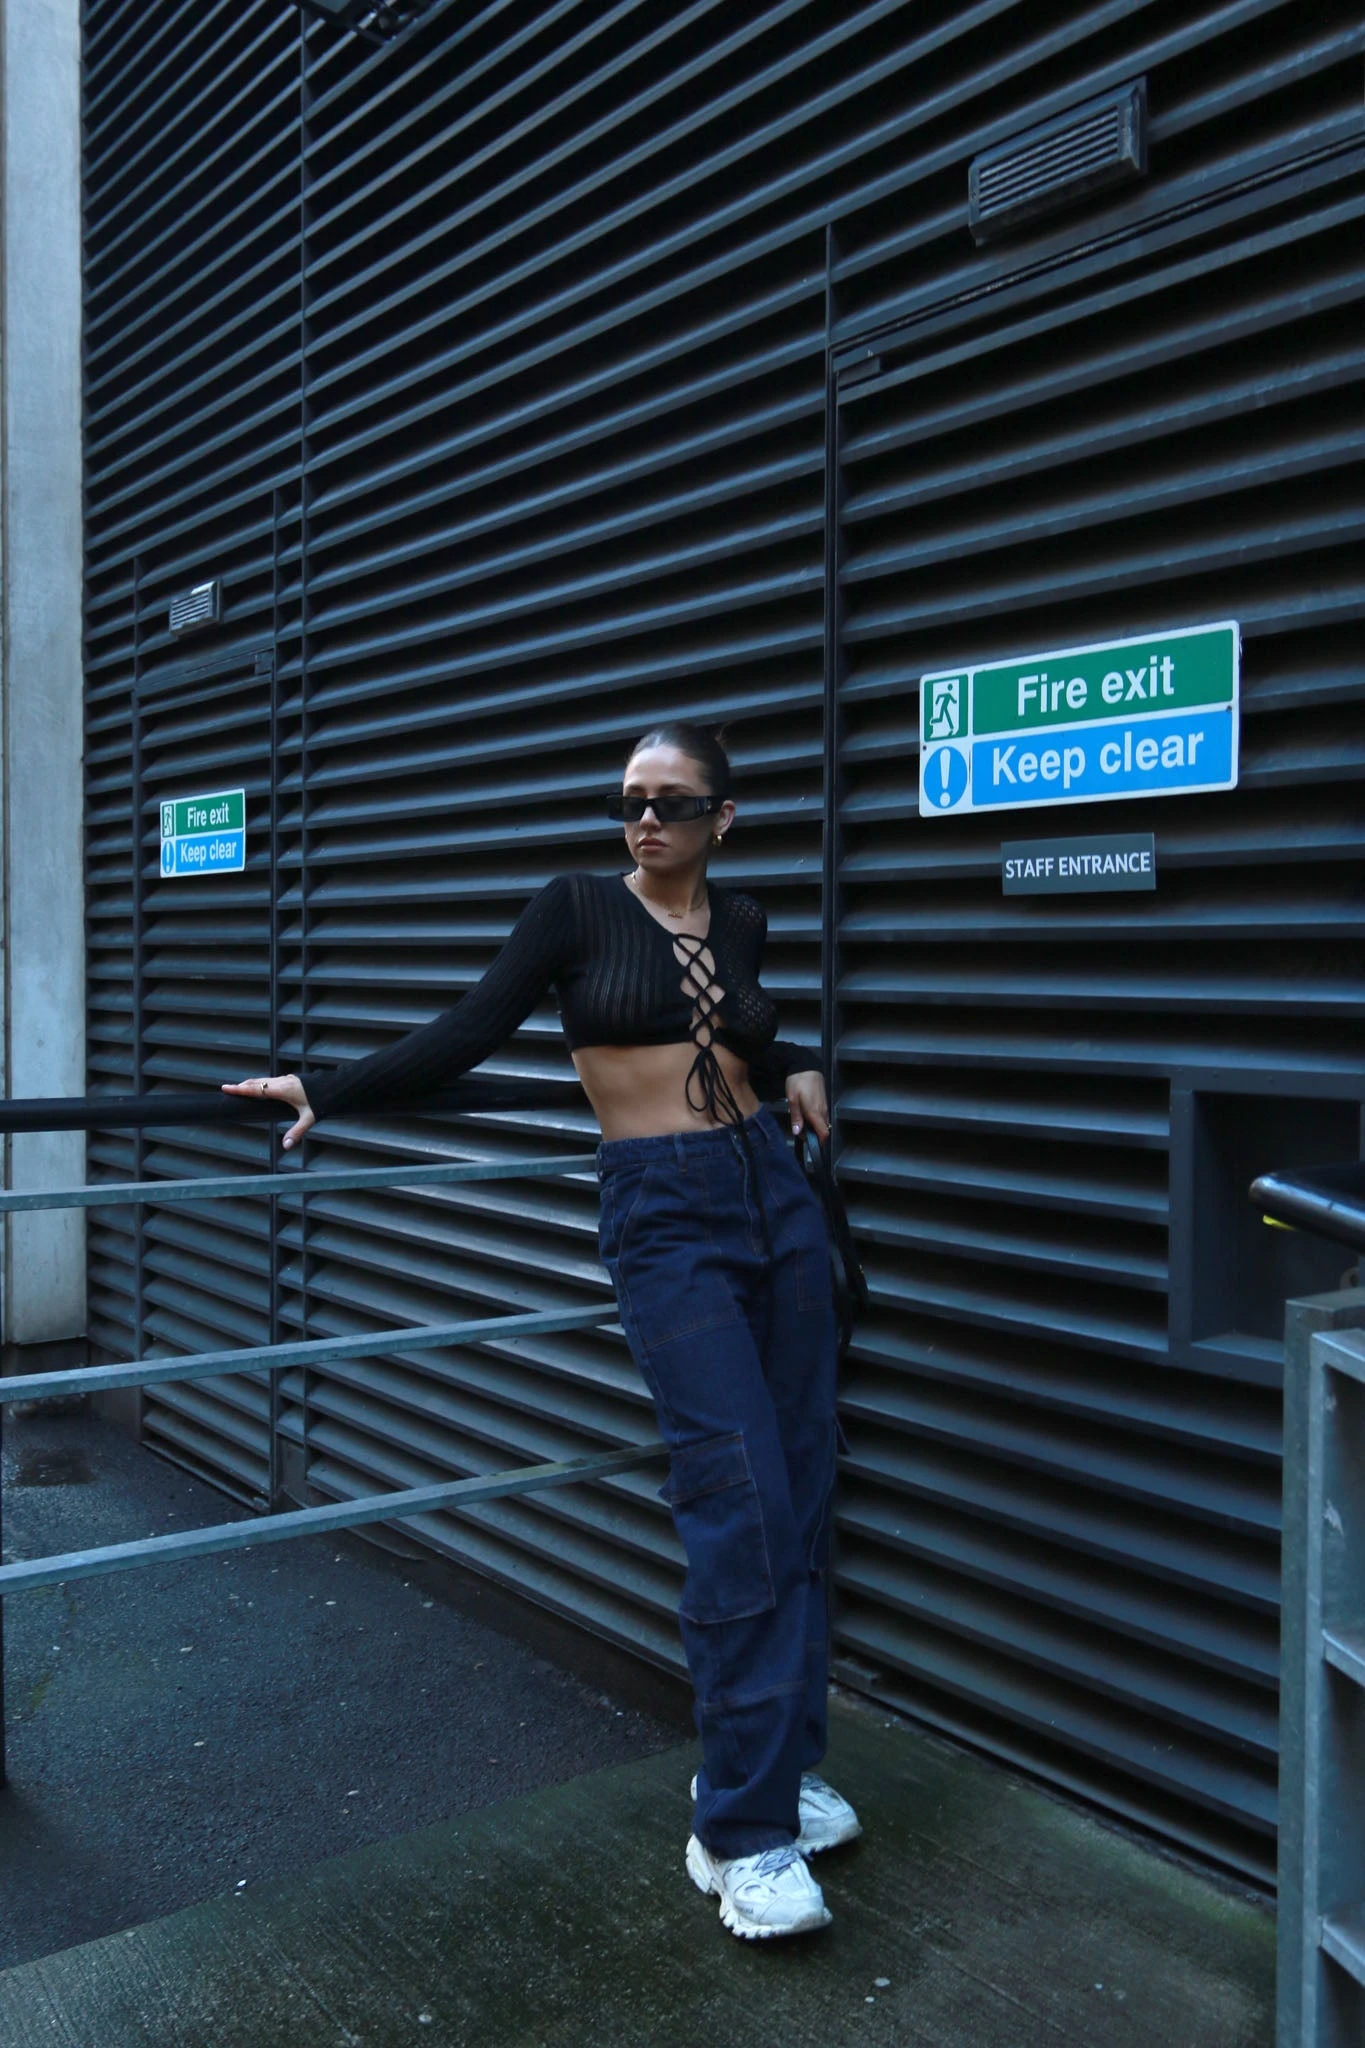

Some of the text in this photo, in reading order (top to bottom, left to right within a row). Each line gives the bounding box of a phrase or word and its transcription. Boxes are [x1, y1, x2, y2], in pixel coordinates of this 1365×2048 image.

[1018, 655, 1174, 716] Fire exit
[992, 731, 1204, 789] Keep clear
[187, 802, 229, 827] Fire exit
[180, 839, 236, 867] Keep clear
[1005, 852, 1151, 879] STAFF ENTRANCE
